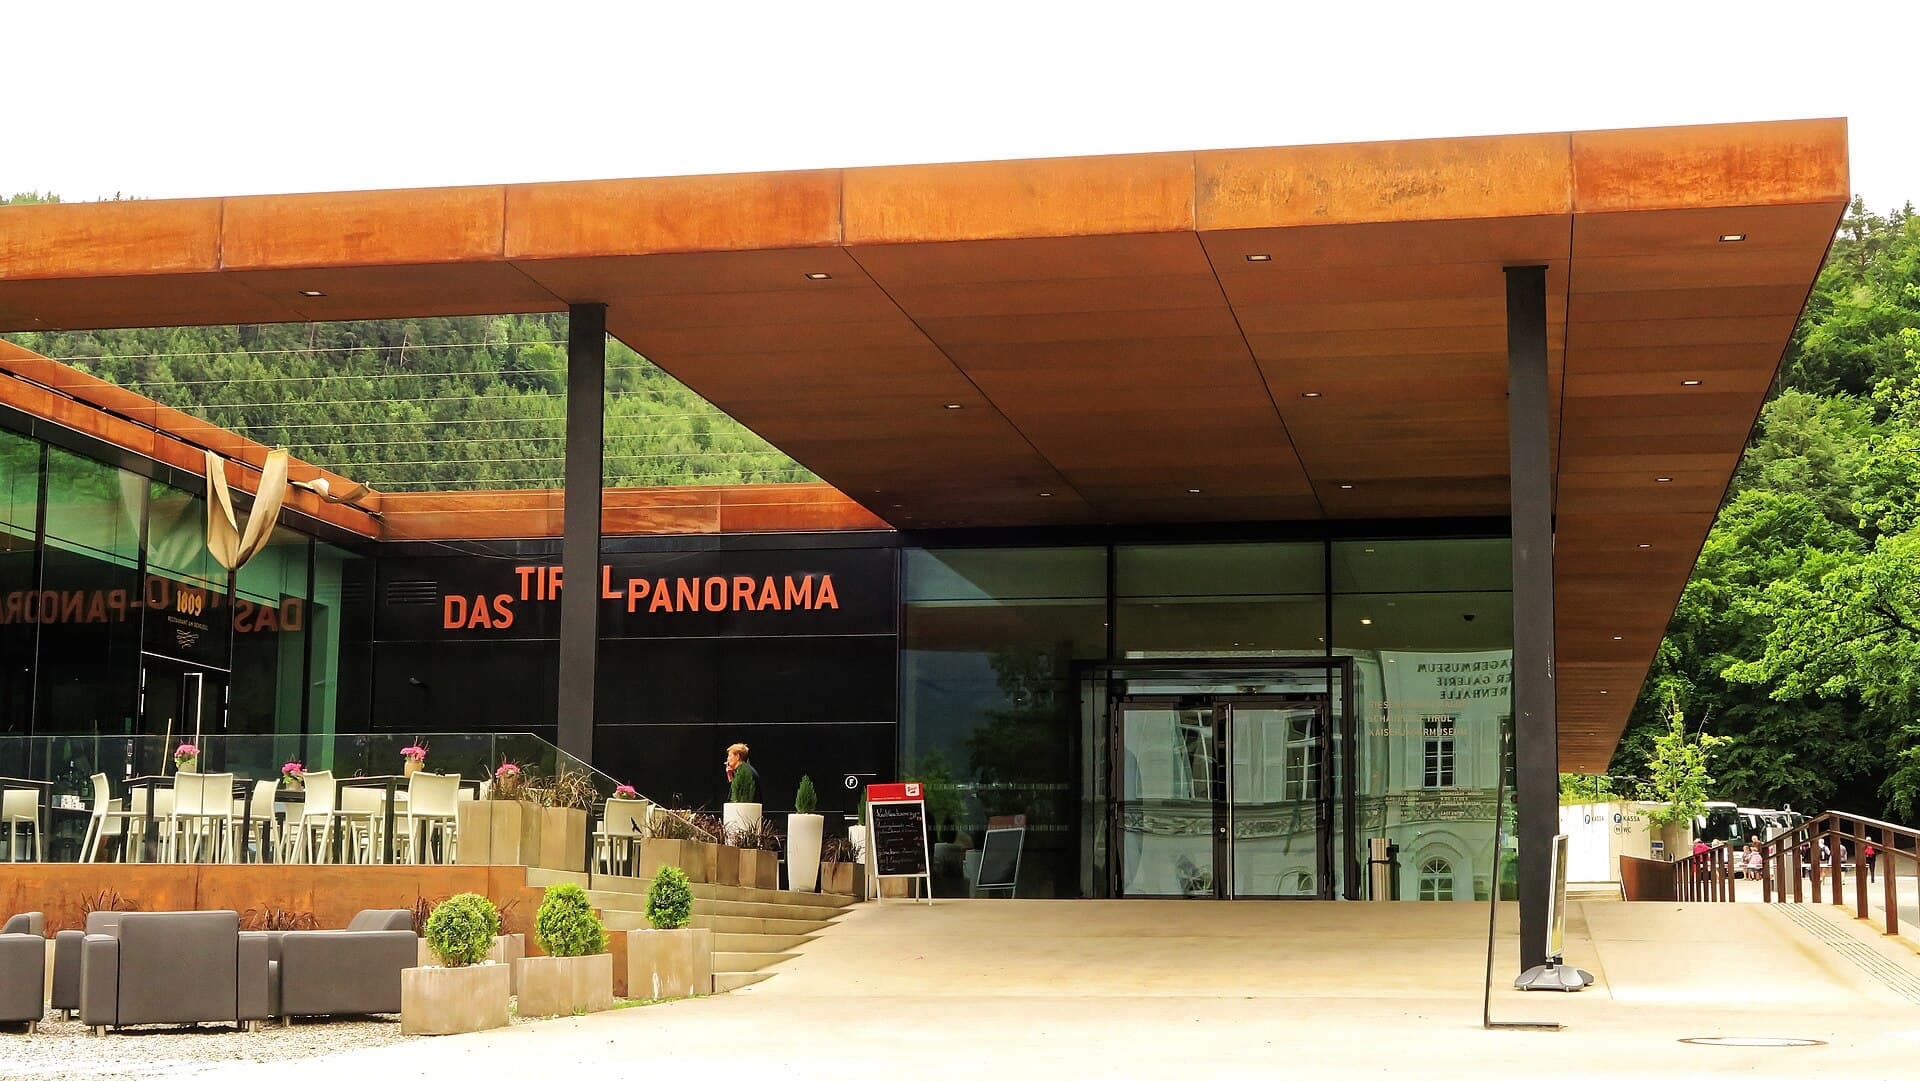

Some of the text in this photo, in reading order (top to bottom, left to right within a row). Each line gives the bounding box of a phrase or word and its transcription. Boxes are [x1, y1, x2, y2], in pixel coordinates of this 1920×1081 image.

[176, 590, 202, 616] 1809
[443, 565, 839, 629] DAS TIRL PANORAMA
